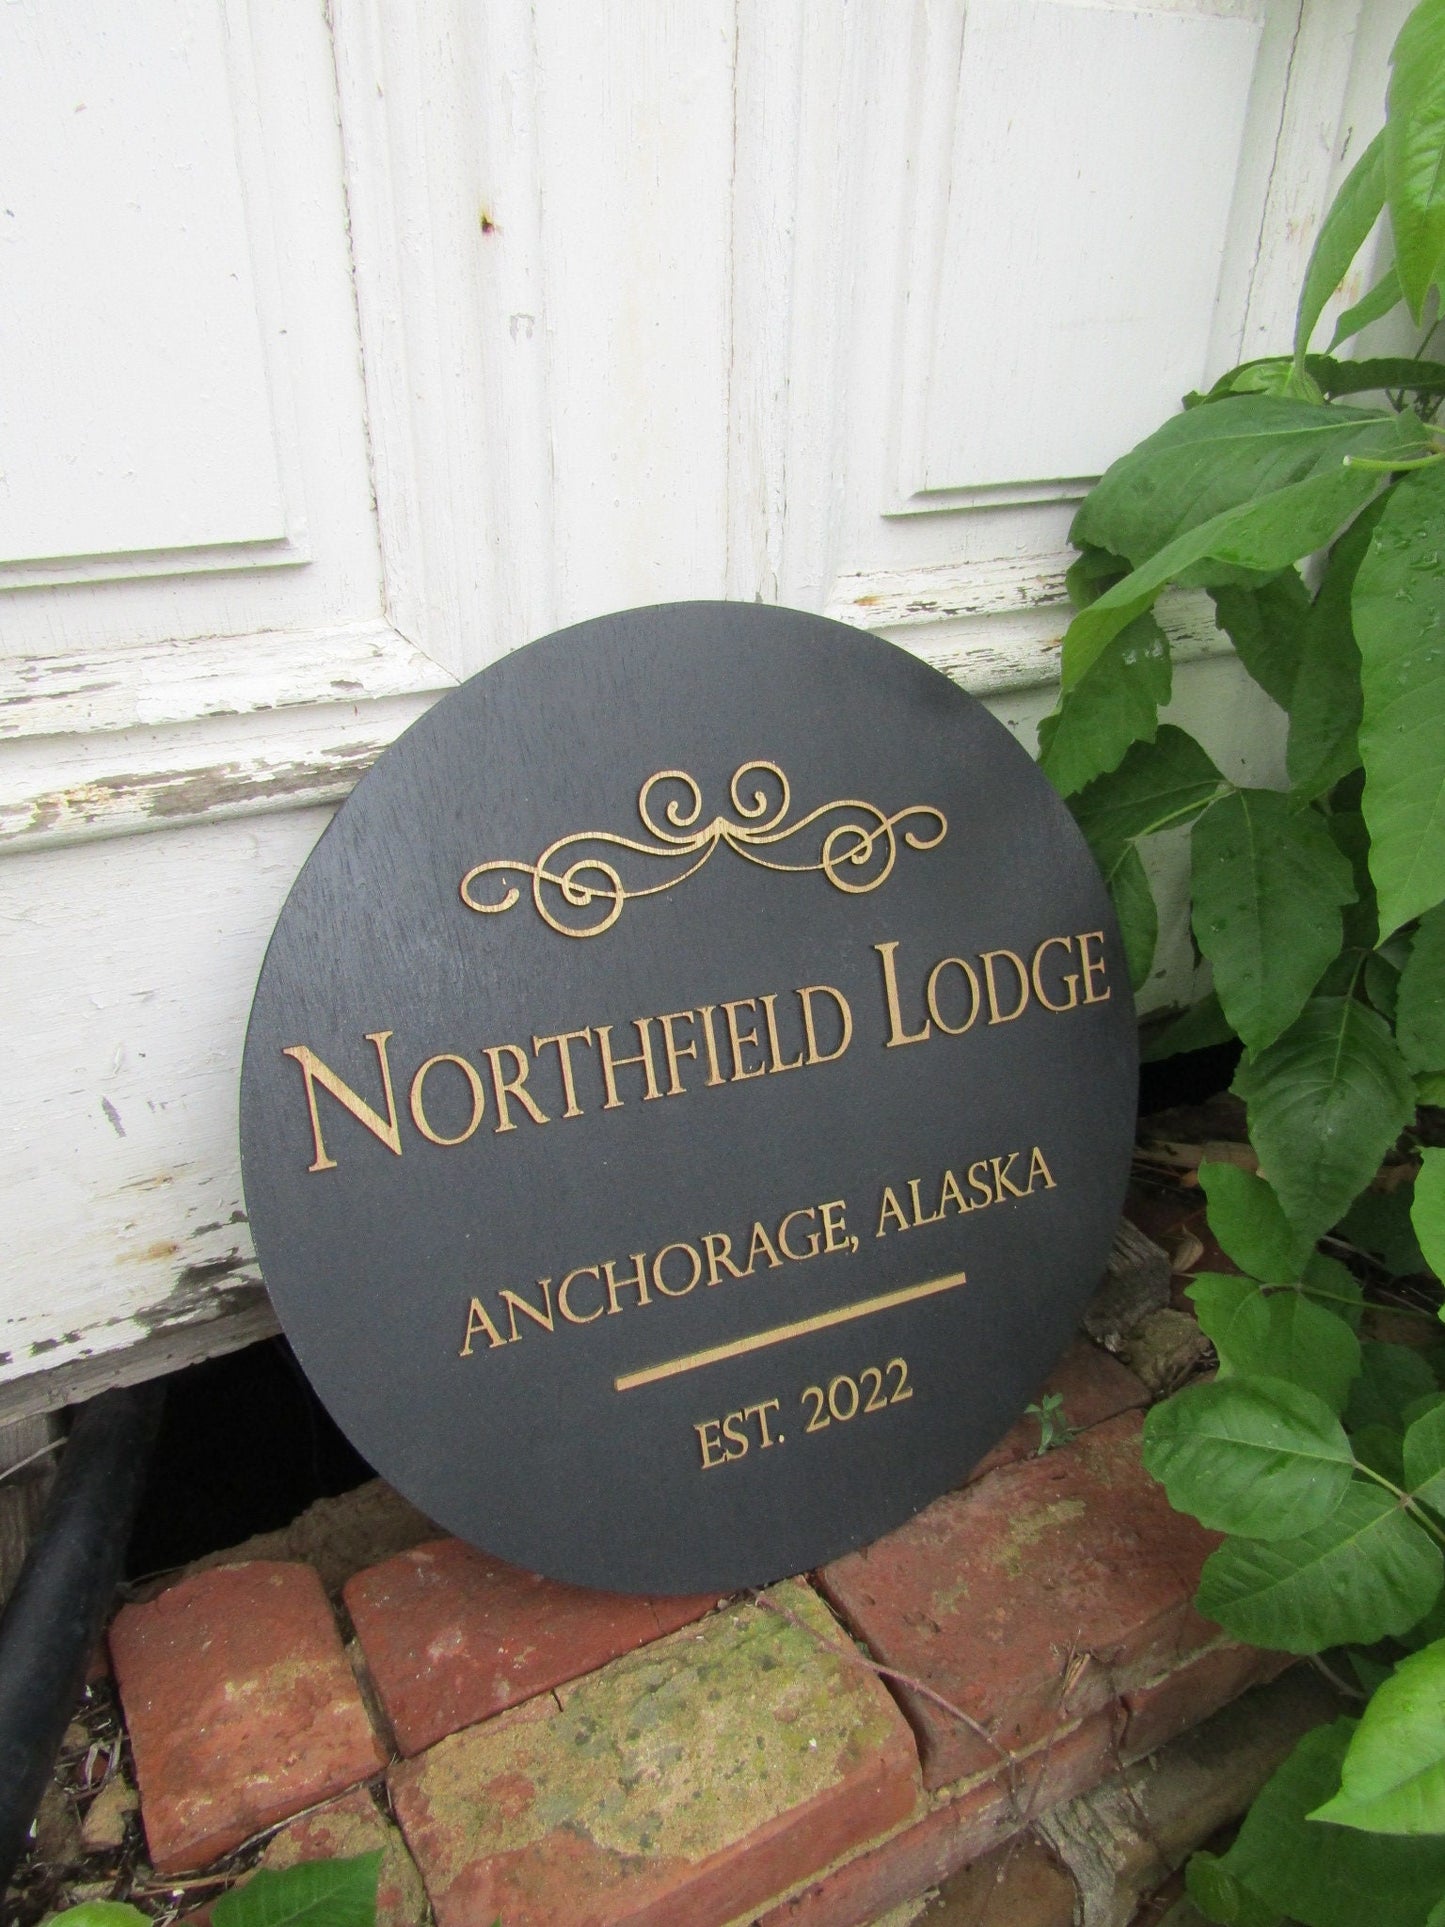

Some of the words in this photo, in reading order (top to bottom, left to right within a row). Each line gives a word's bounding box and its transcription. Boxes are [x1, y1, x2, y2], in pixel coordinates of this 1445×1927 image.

[283, 984, 854, 1172] NORTHFIELD
[874, 930, 1112, 1049] LODGE
[458, 1199, 860, 1357] ANCHORAGE,
[876, 1146, 1056, 1238] ALASKA
[694, 1398, 786, 1470] EST.
[801, 1357, 914, 1434] 2022
